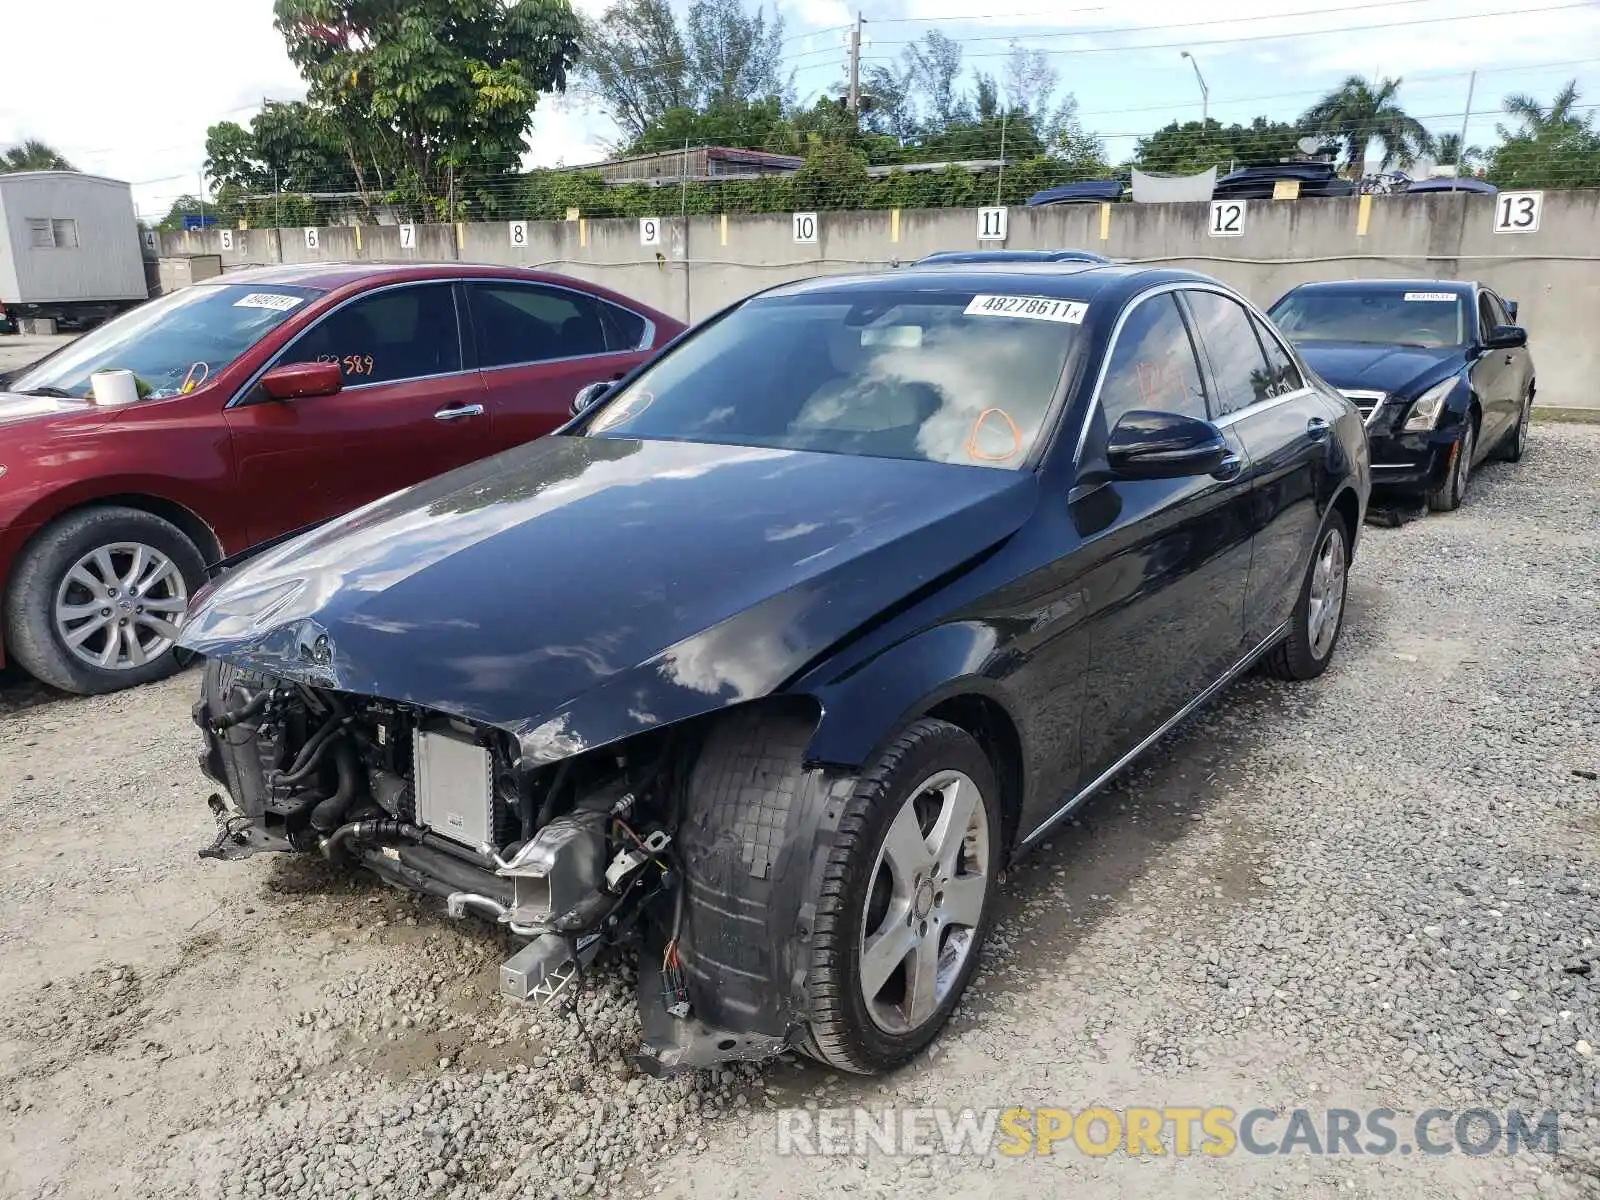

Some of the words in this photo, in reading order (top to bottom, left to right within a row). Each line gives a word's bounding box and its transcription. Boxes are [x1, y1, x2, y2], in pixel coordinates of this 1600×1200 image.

[1214, 205, 1241, 232] 12
[1500, 197, 1535, 227] 13
[645, 222, 655, 241] 9
[795, 216, 814, 239] 10
[982, 211, 1001, 236] 11
[147, 233, 154, 249] 4
[223, 232, 230, 248] 5
[308, 230, 316, 247] 6
[403, 228, 411, 246] 7
[514, 224, 524, 243] 8
